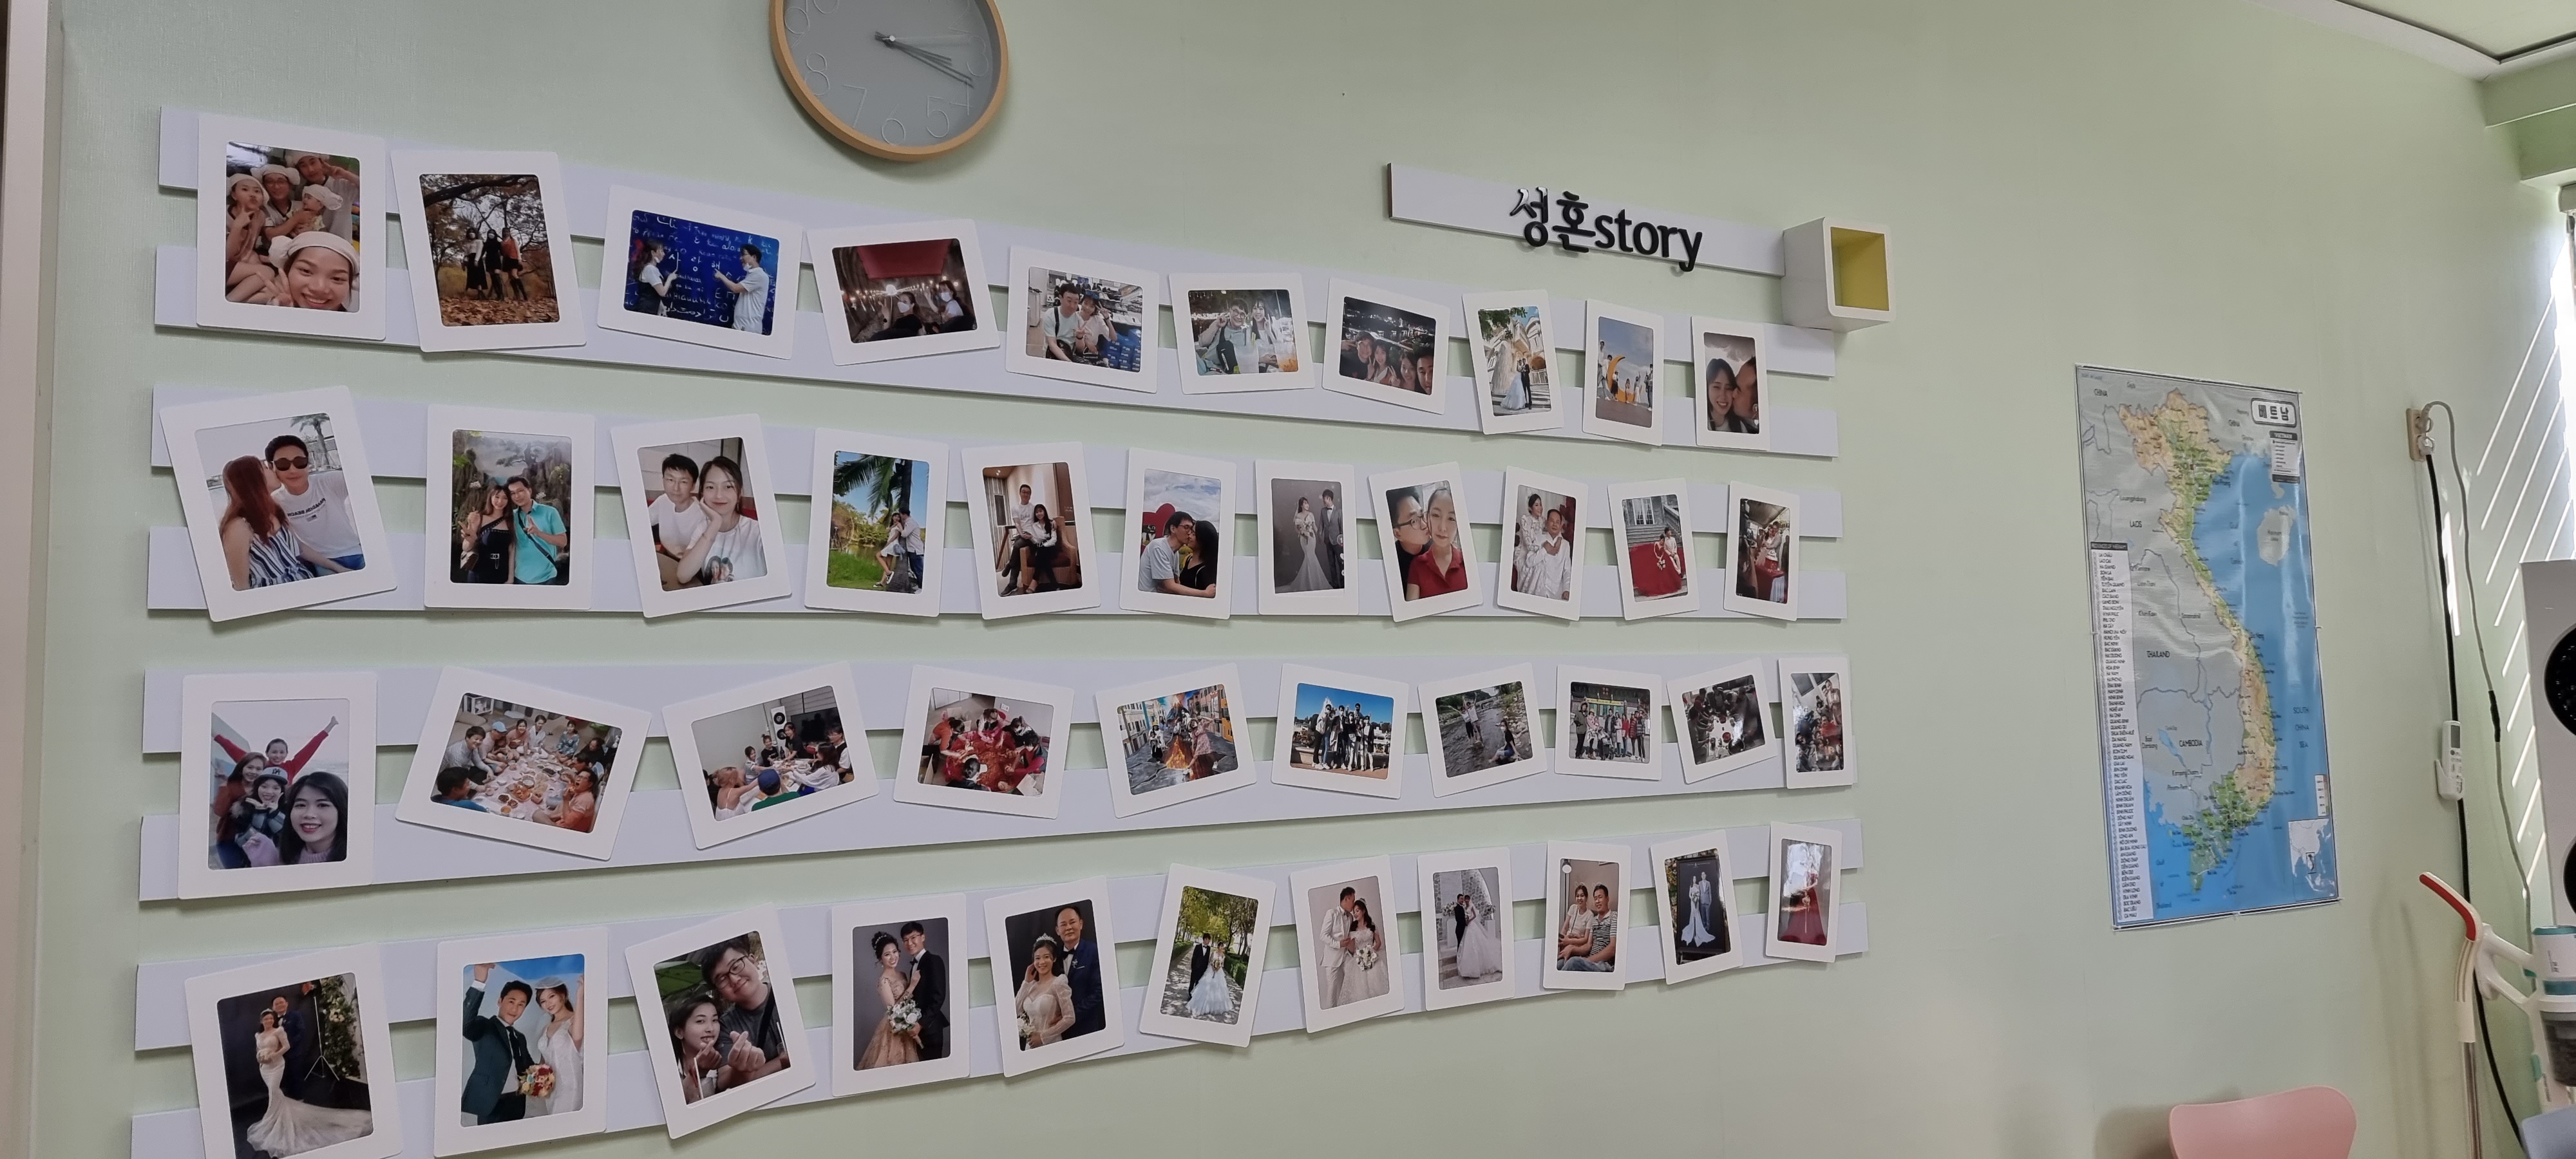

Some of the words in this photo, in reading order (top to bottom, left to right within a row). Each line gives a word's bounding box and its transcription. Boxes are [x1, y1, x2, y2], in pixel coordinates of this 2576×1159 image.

[784, 6, 810, 50] 9
[805, 52, 830, 96] 8
[967, 35, 989, 77] 3
[842, 84, 867, 129] 7
[880, 103, 905, 146] 6
[926, 95, 950, 138] 5
[2179, 739, 2203, 748] CAMBODIA
